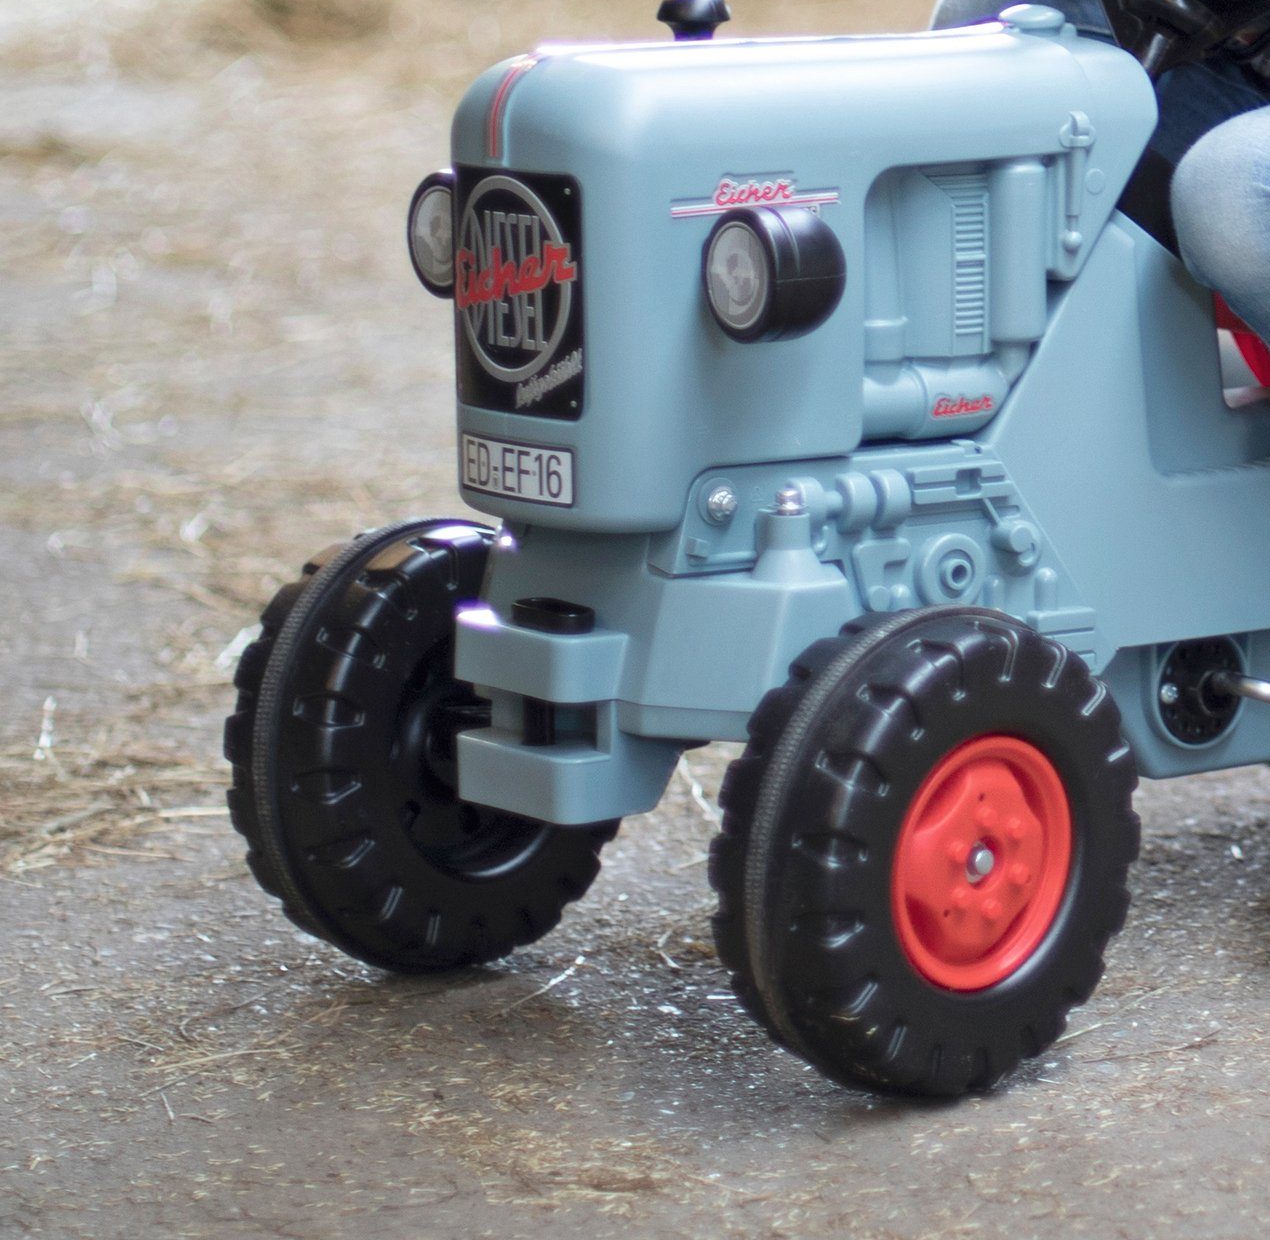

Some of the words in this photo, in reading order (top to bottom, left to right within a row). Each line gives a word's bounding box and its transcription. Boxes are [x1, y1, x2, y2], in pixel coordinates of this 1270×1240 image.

[714, 180, 795, 206] Eicher
[455, 241, 577, 310] Eicher
[932, 396, 994, 418] Eicher
